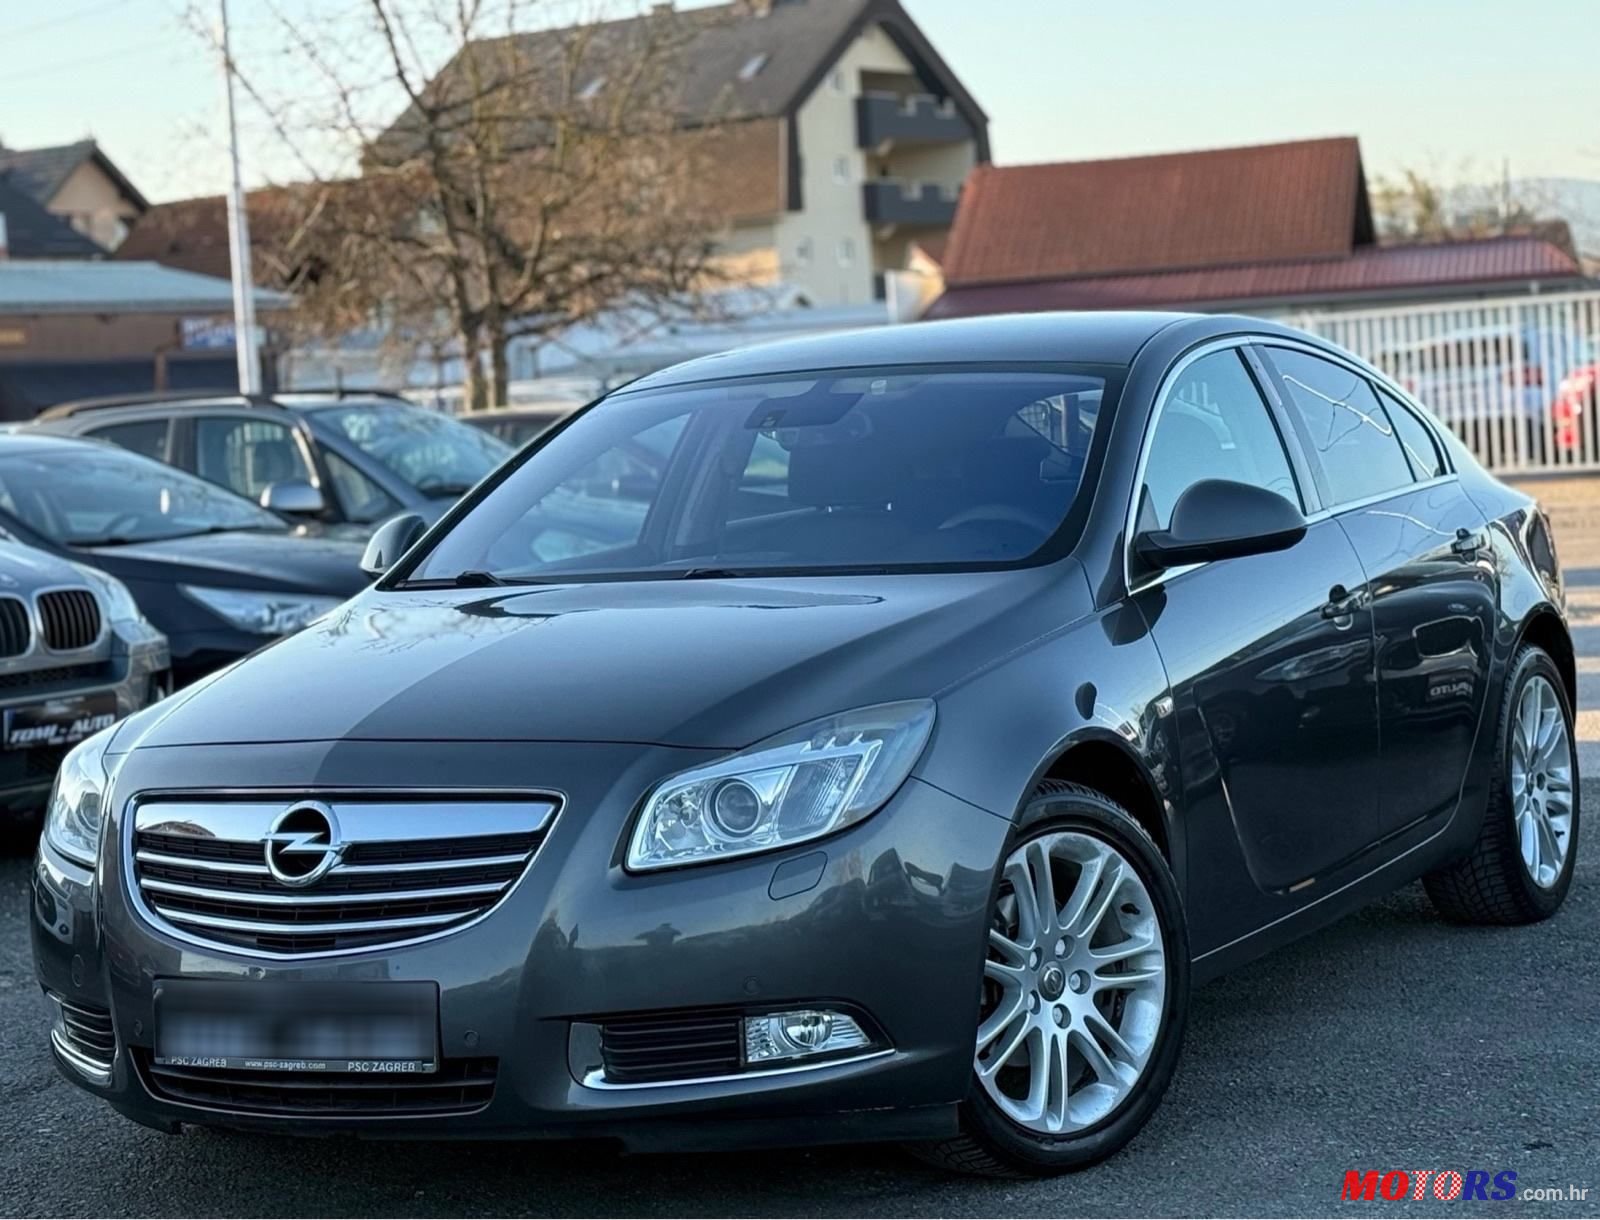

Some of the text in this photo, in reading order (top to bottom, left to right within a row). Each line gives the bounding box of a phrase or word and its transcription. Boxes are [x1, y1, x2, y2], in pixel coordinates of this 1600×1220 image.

[69, 714, 116, 735] AUTO
[171, 1056, 416, 1073] PSC ZAGREB www.psc-zagreb.com PSC ZAGREB
